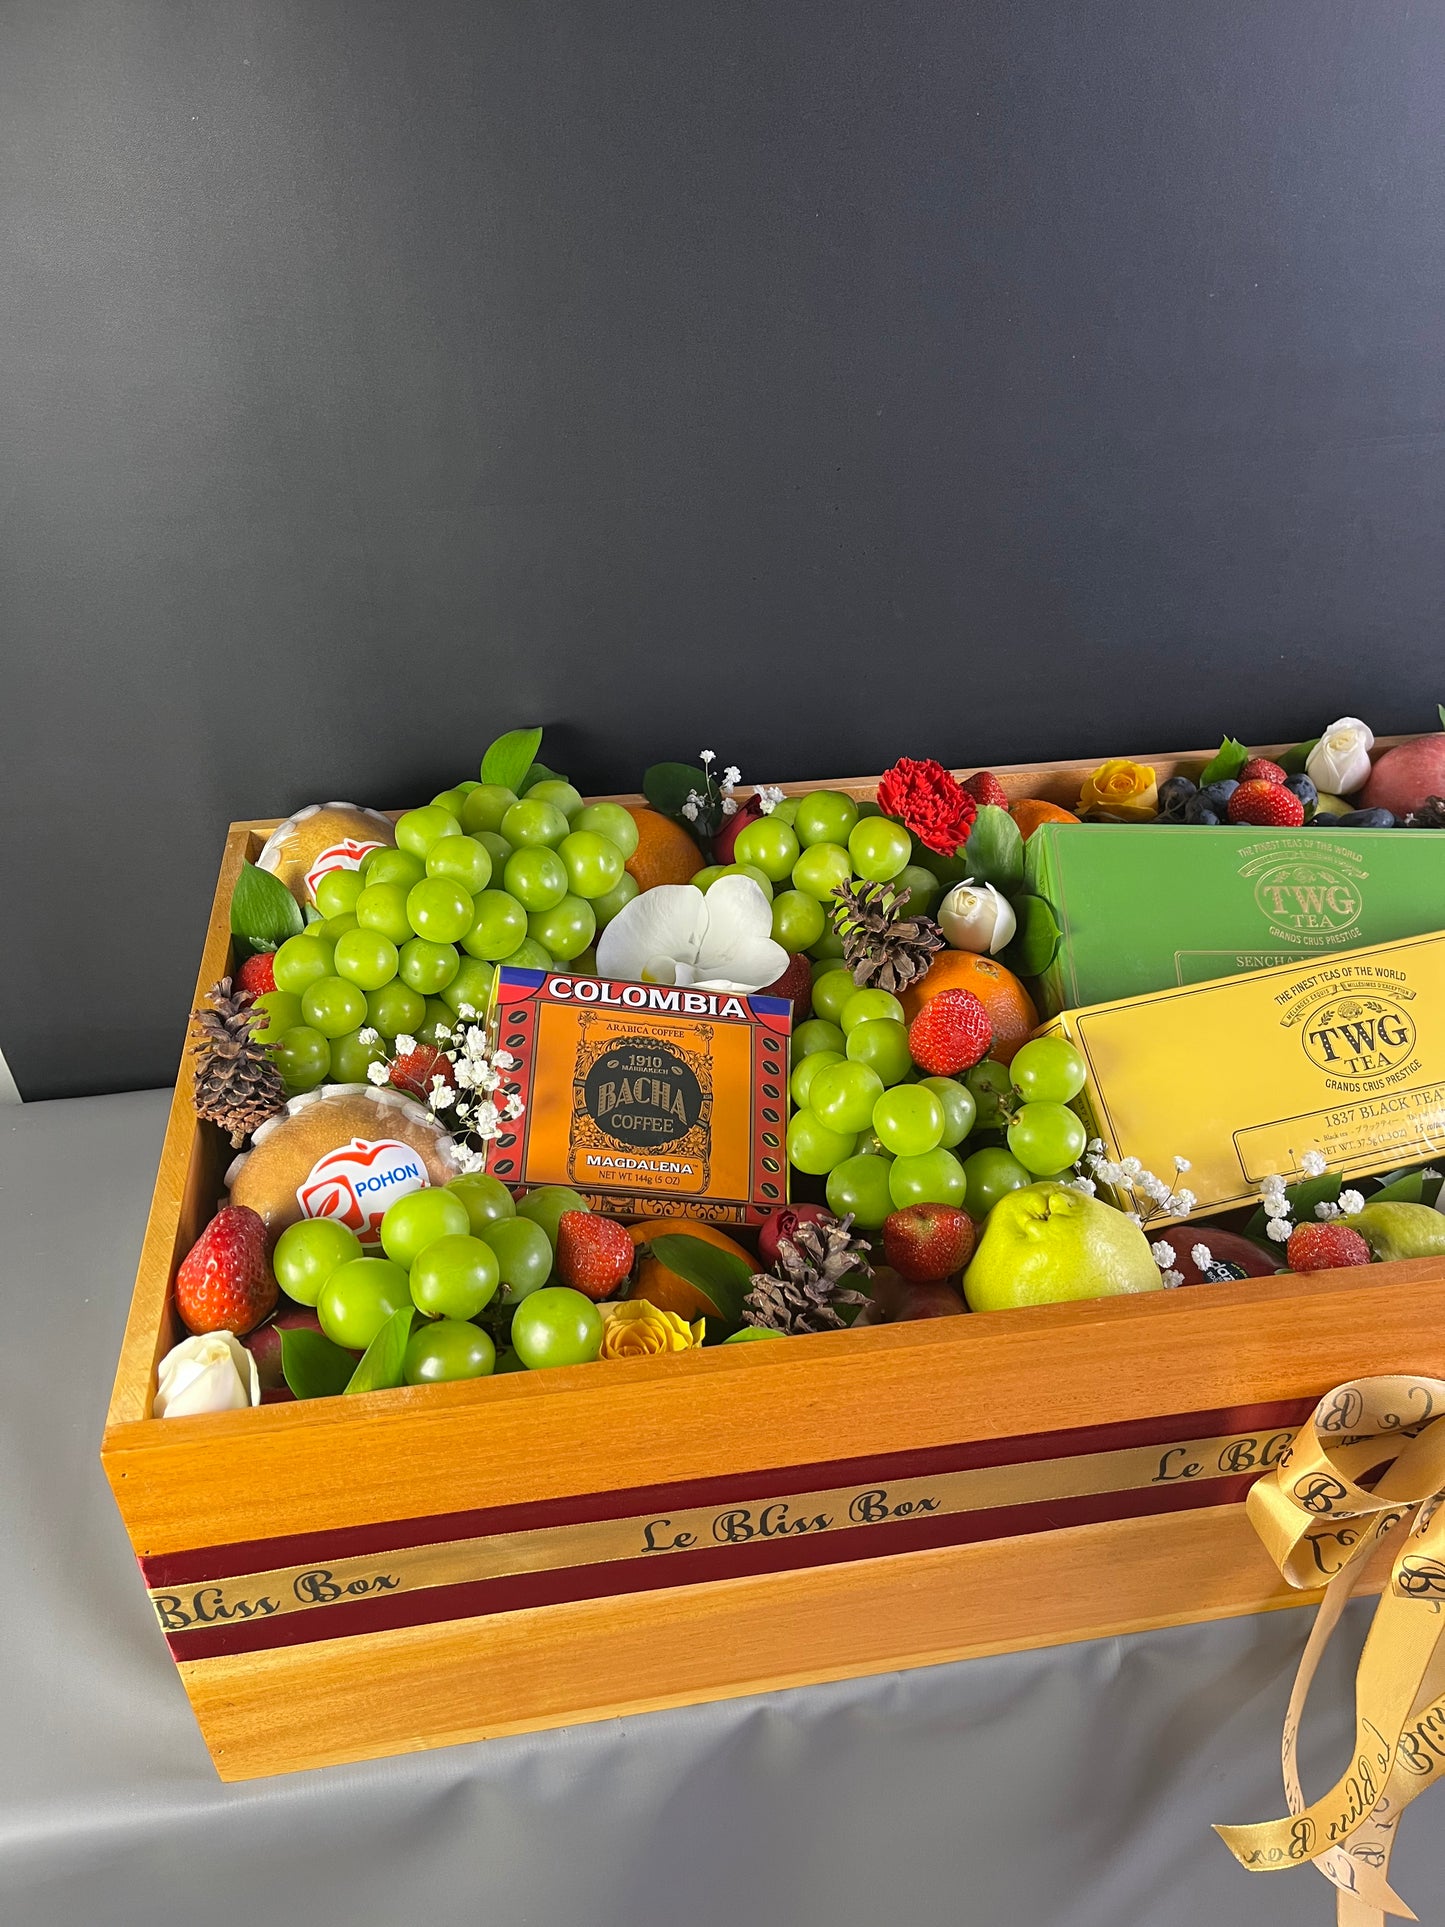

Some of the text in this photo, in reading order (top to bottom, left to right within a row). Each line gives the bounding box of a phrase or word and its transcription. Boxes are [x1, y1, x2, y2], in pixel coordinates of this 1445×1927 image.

[1238, 839, 1363, 862] THE FINEST TEAS OF THE WORLD
[1263, 886, 1356, 915] TWG
[1290, 915, 1335, 928] TEA
[1269, 926, 1363, 946] GRANDS CRUS PRESTIGE
[549, 978, 748, 1019] COLOMBIA
[1274, 966, 1407, 1006] THE FINEST TEAS OF THE WORLD
[606, 1023, 685, 1038] ARABICA COFFEE
[1309, 1014, 1409, 1062] TWG
[622, 1065, 669, 1075] MARRAKECH
[629, 1054, 663, 1068] 1910
[1343, 1052, 1393, 1074] TEA
[1325, 1058, 1423, 1092] GRANDS CRUS PRESTIGE
[597, 1077, 688, 1126] BACHA
[1325, 1110, 1355, 1128] 1837
[1360, 1097, 1410, 1119] BLACK
[611, 1114, 674, 1133] COFFEE
[1415, 1123, 1424, 1134] 15
[1319, 1146, 1337, 1156] NET
[1339, 1141, 1357, 1151] WT.
[355, 1163, 419, 1198] POHON
[599, 1170, 681, 1186] NET WT. 144g (5 OZ)
[1152, 1448, 1204, 1482] Le
[1218, 1433, 1292, 1472] Bli
[641, 1489, 942, 1553] Le Bliss Box
[152, 1569, 401, 1629] Bliss Box
